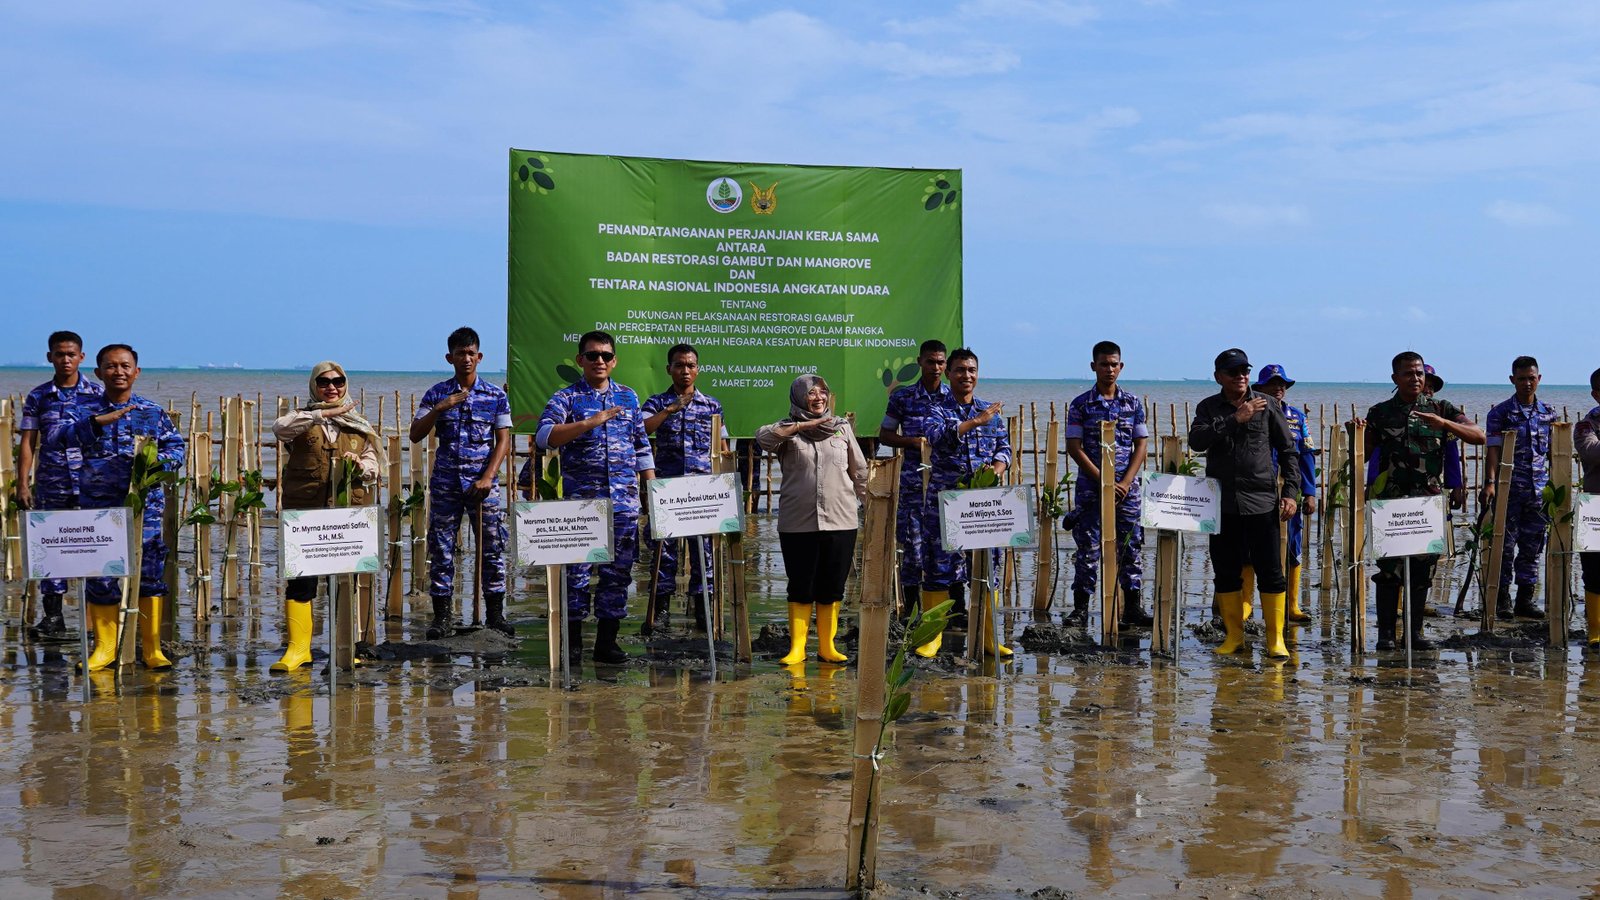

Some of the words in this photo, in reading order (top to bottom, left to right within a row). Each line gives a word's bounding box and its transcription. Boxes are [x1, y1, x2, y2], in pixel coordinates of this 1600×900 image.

[598, 223, 725, 239] PENANDATANGANAN
[728, 228, 803, 241] PERJANJIAN
[806, 230, 844, 242] KERJA
[846, 232, 880, 243] SAMA
[716, 242, 766, 253] ANTARA
[606, 251, 650, 263] BADAN
[652, 253, 719, 266] RESTORASI
[721, 255, 774, 267] GAMBUT
[776, 257, 802, 267] DAN
[804, 257, 872, 269] MANGROVE
[729, 269, 756, 280] DAN
[589, 278, 646, 291] TENTARA
[649, 280, 711, 293] NASIONAL
[713, 282, 780, 294] INDONESIA
[783, 283, 848, 295] ANGKATAN
[850, 285, 890, 296] UDARA
[720, 299, 767, 310] TENTANG
[627, 309, 683, 320] DUKUNGAN
[685, 311, 757, 322] PELAKSANAAN
[759, 312, 812, 323] RESTORASI
[814, 313, 855, 323] GAMBUT
[595, 321, 617, 331] DAN
[619, 322, 683, 333] PERCEPATAN
[684, 324, 749, 334] REHABILITASI
[751, 325, 807, 335] MANGROVE
[809, 325, 843, 335] DALAM
[845, 326, 884, 336] RANGKA
[615, 335, 675, 345] KETAHANAN
[677, 336, 720, 346] WILAYAH
[722, 337, 763, 347] NEGARA
[765, 337, 816, 347] KESATUAN
[819, 338, 863, 348] REPUBLIK
[865, 339, 917, 348] INDONESIA
[728, 365, 787, 374] KALIMANTAN
[789, 365, 818, 374] TIMUR
[712, 379, 718, 388] 2
[719, 379, 751, 388] MARET
[753, 379, 775, 388] 2024
[676, 496, 688, 505] Ayu
[60, 536, 68, 544] Ali
